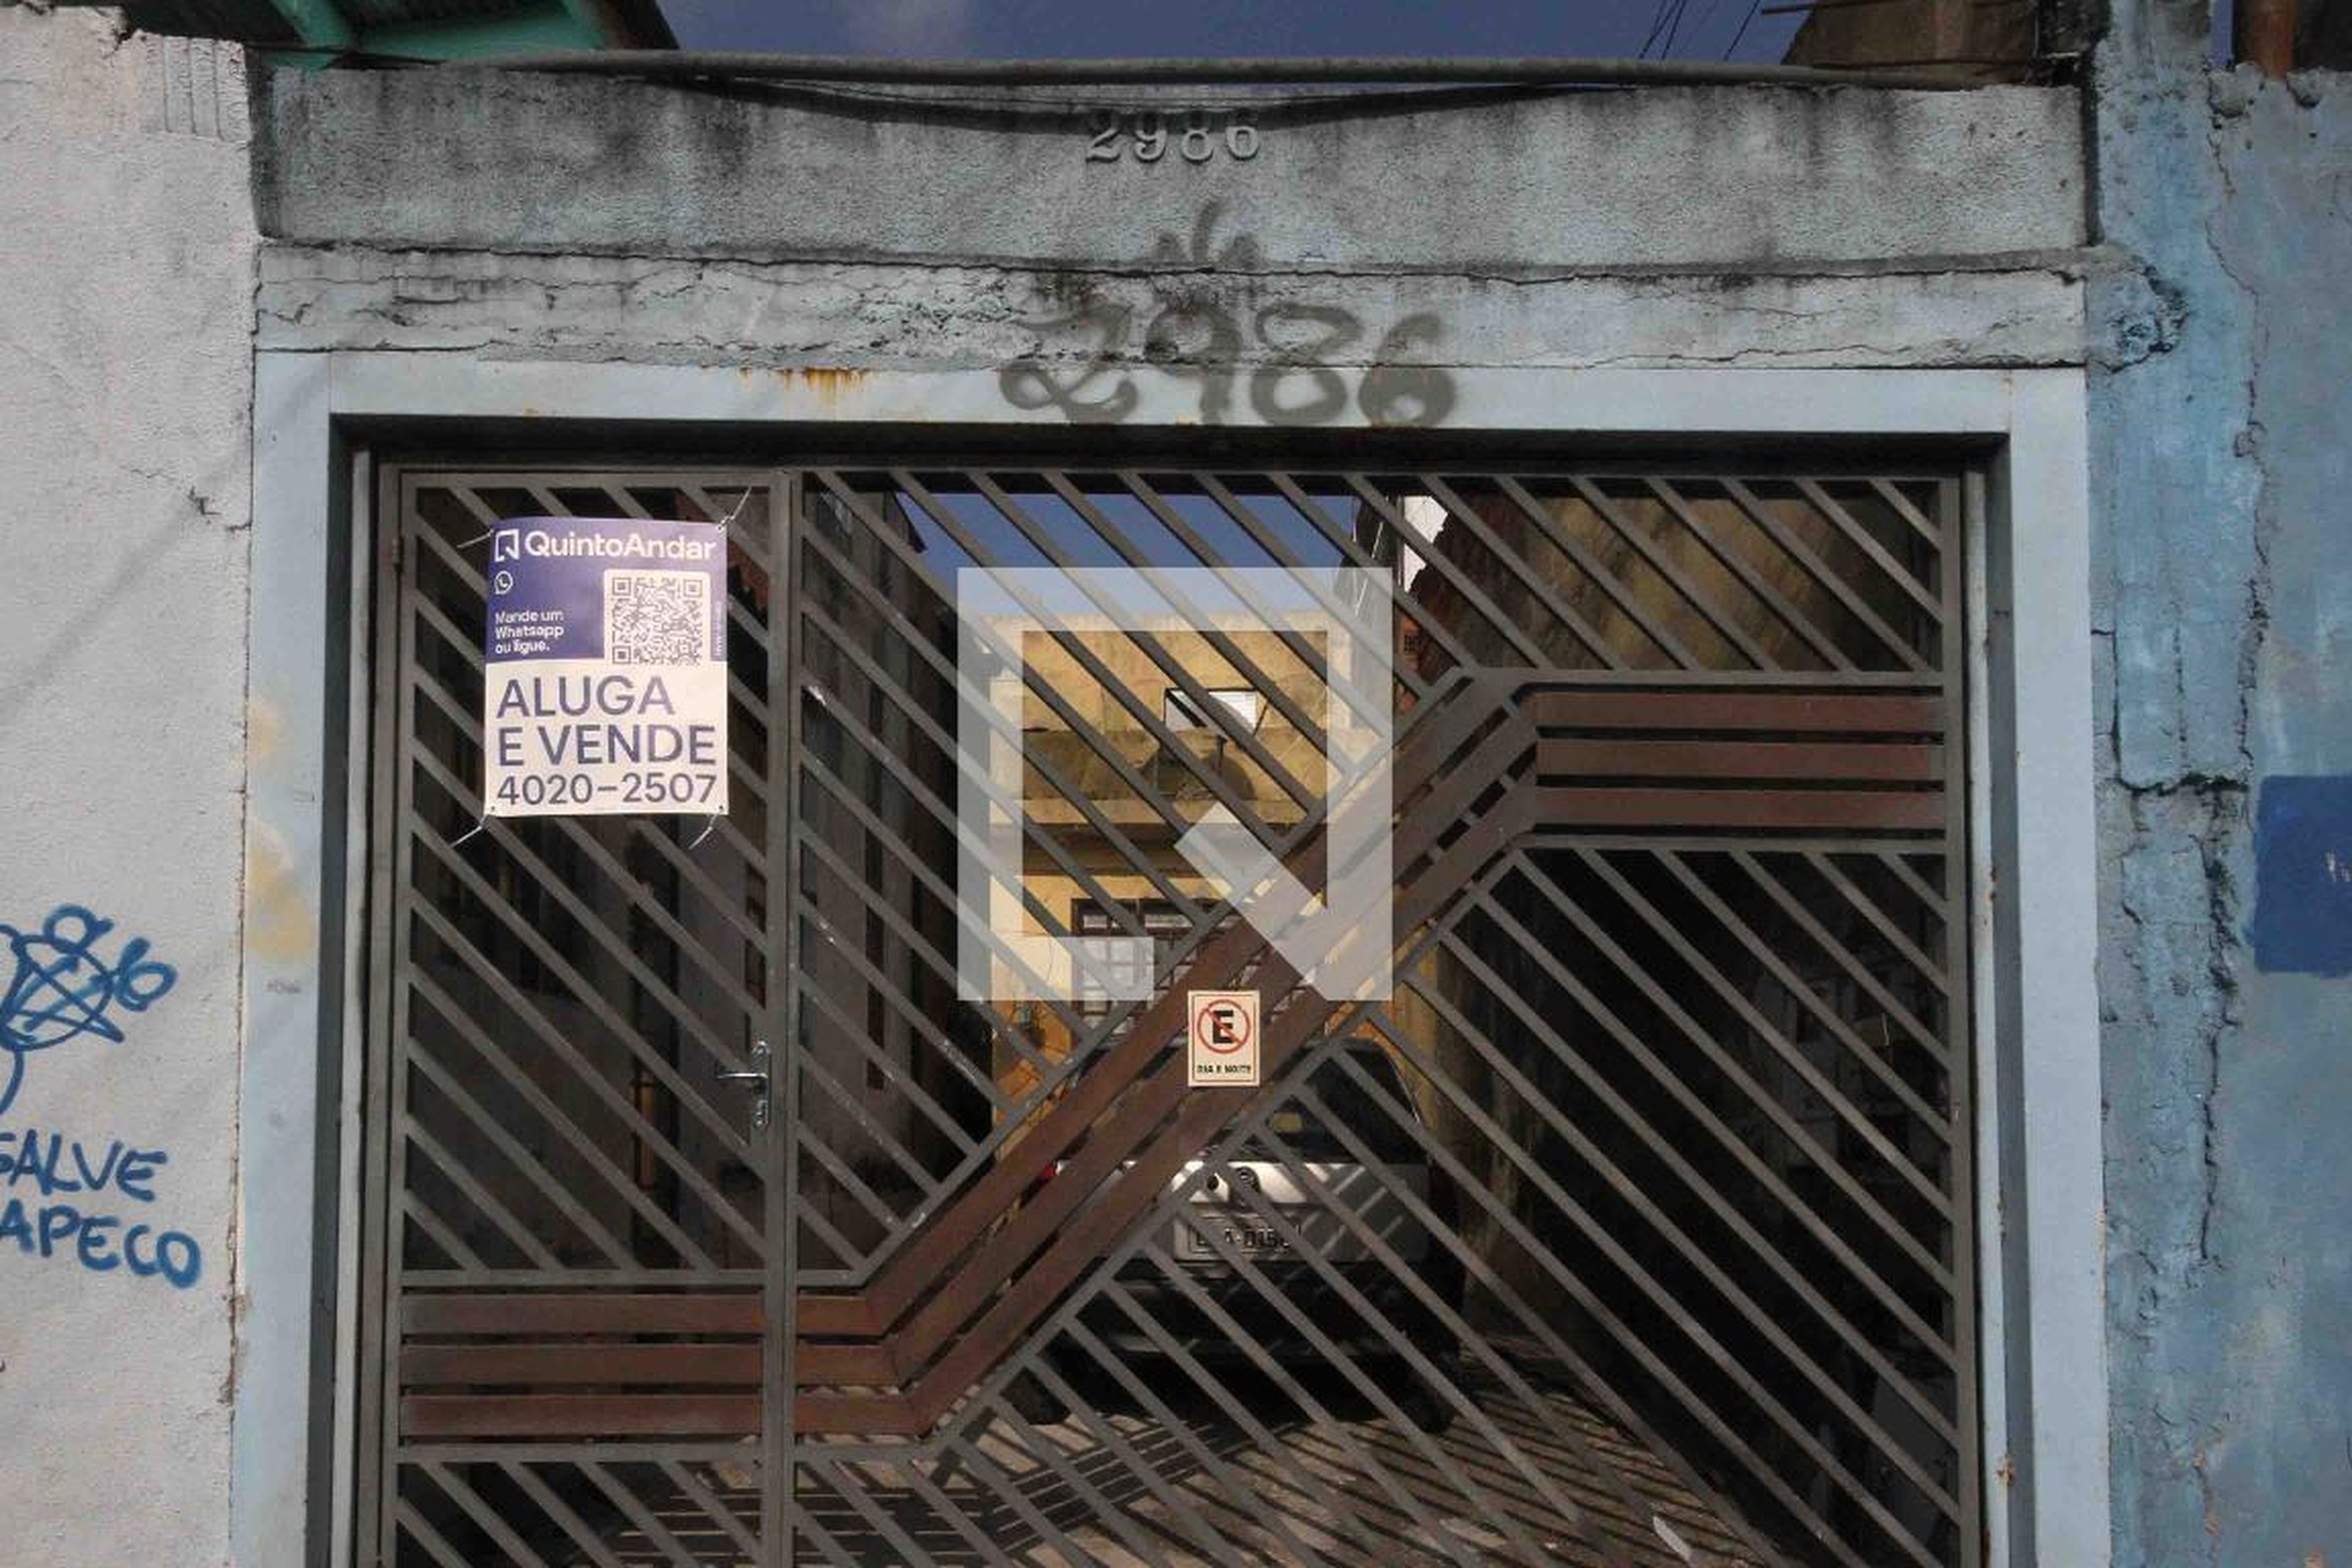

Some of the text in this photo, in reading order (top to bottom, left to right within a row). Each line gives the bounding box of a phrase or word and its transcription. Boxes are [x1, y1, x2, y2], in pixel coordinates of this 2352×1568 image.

[1085, 109, 1259, 164] 2986
[524, 530, 717, 561] QuintoAndar
[495, 610, 564, 624] Mande um
[495, 643, 511, 654] ou
[496, 674, 676, 719] ALUGA
[499, 724, 717, 766] E VENDE
[497, 772, 717, 805] 4020-2507
[1213, 1010, 1234, 1044] E
